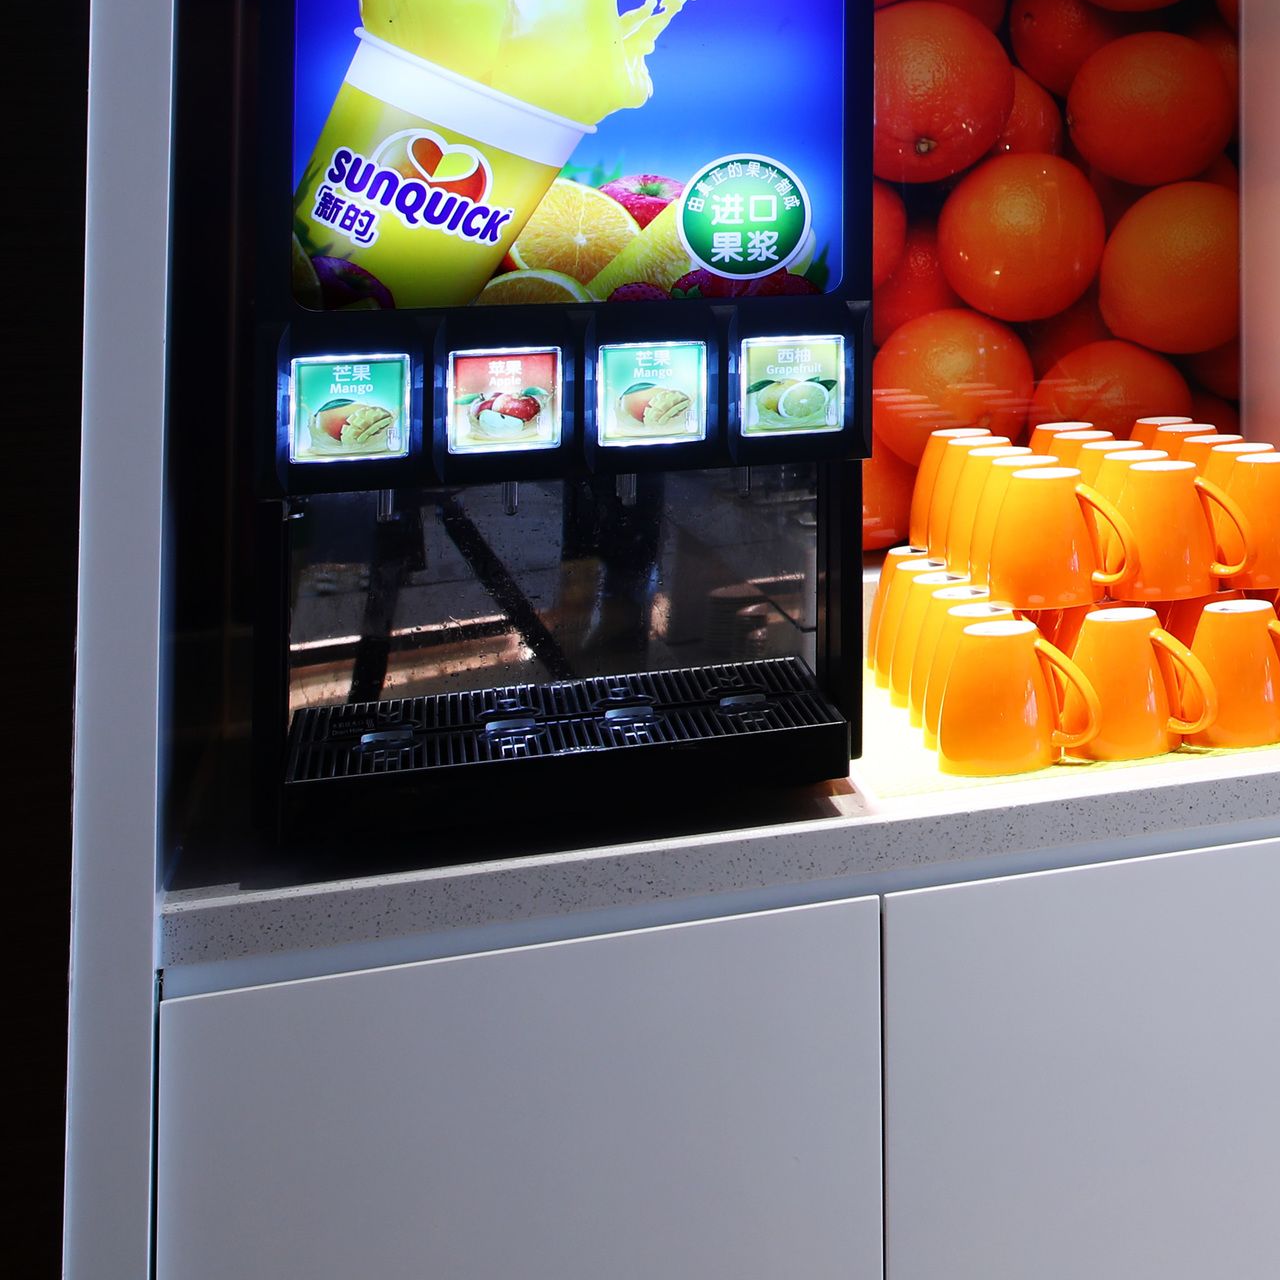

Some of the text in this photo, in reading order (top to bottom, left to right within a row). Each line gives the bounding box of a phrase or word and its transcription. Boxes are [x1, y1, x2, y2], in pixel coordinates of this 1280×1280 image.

[327, 149, 510, 242] SUNQUICK
[711, 193, 778, 225] 进口
[711, 230, 779, 263] 果浆
[635, 350, 671, 367] 芒果
[332, 365, 371, 382] 芒果
[633, 367, 673, 379] Mango
[330, 383, 374, 394] Mango
